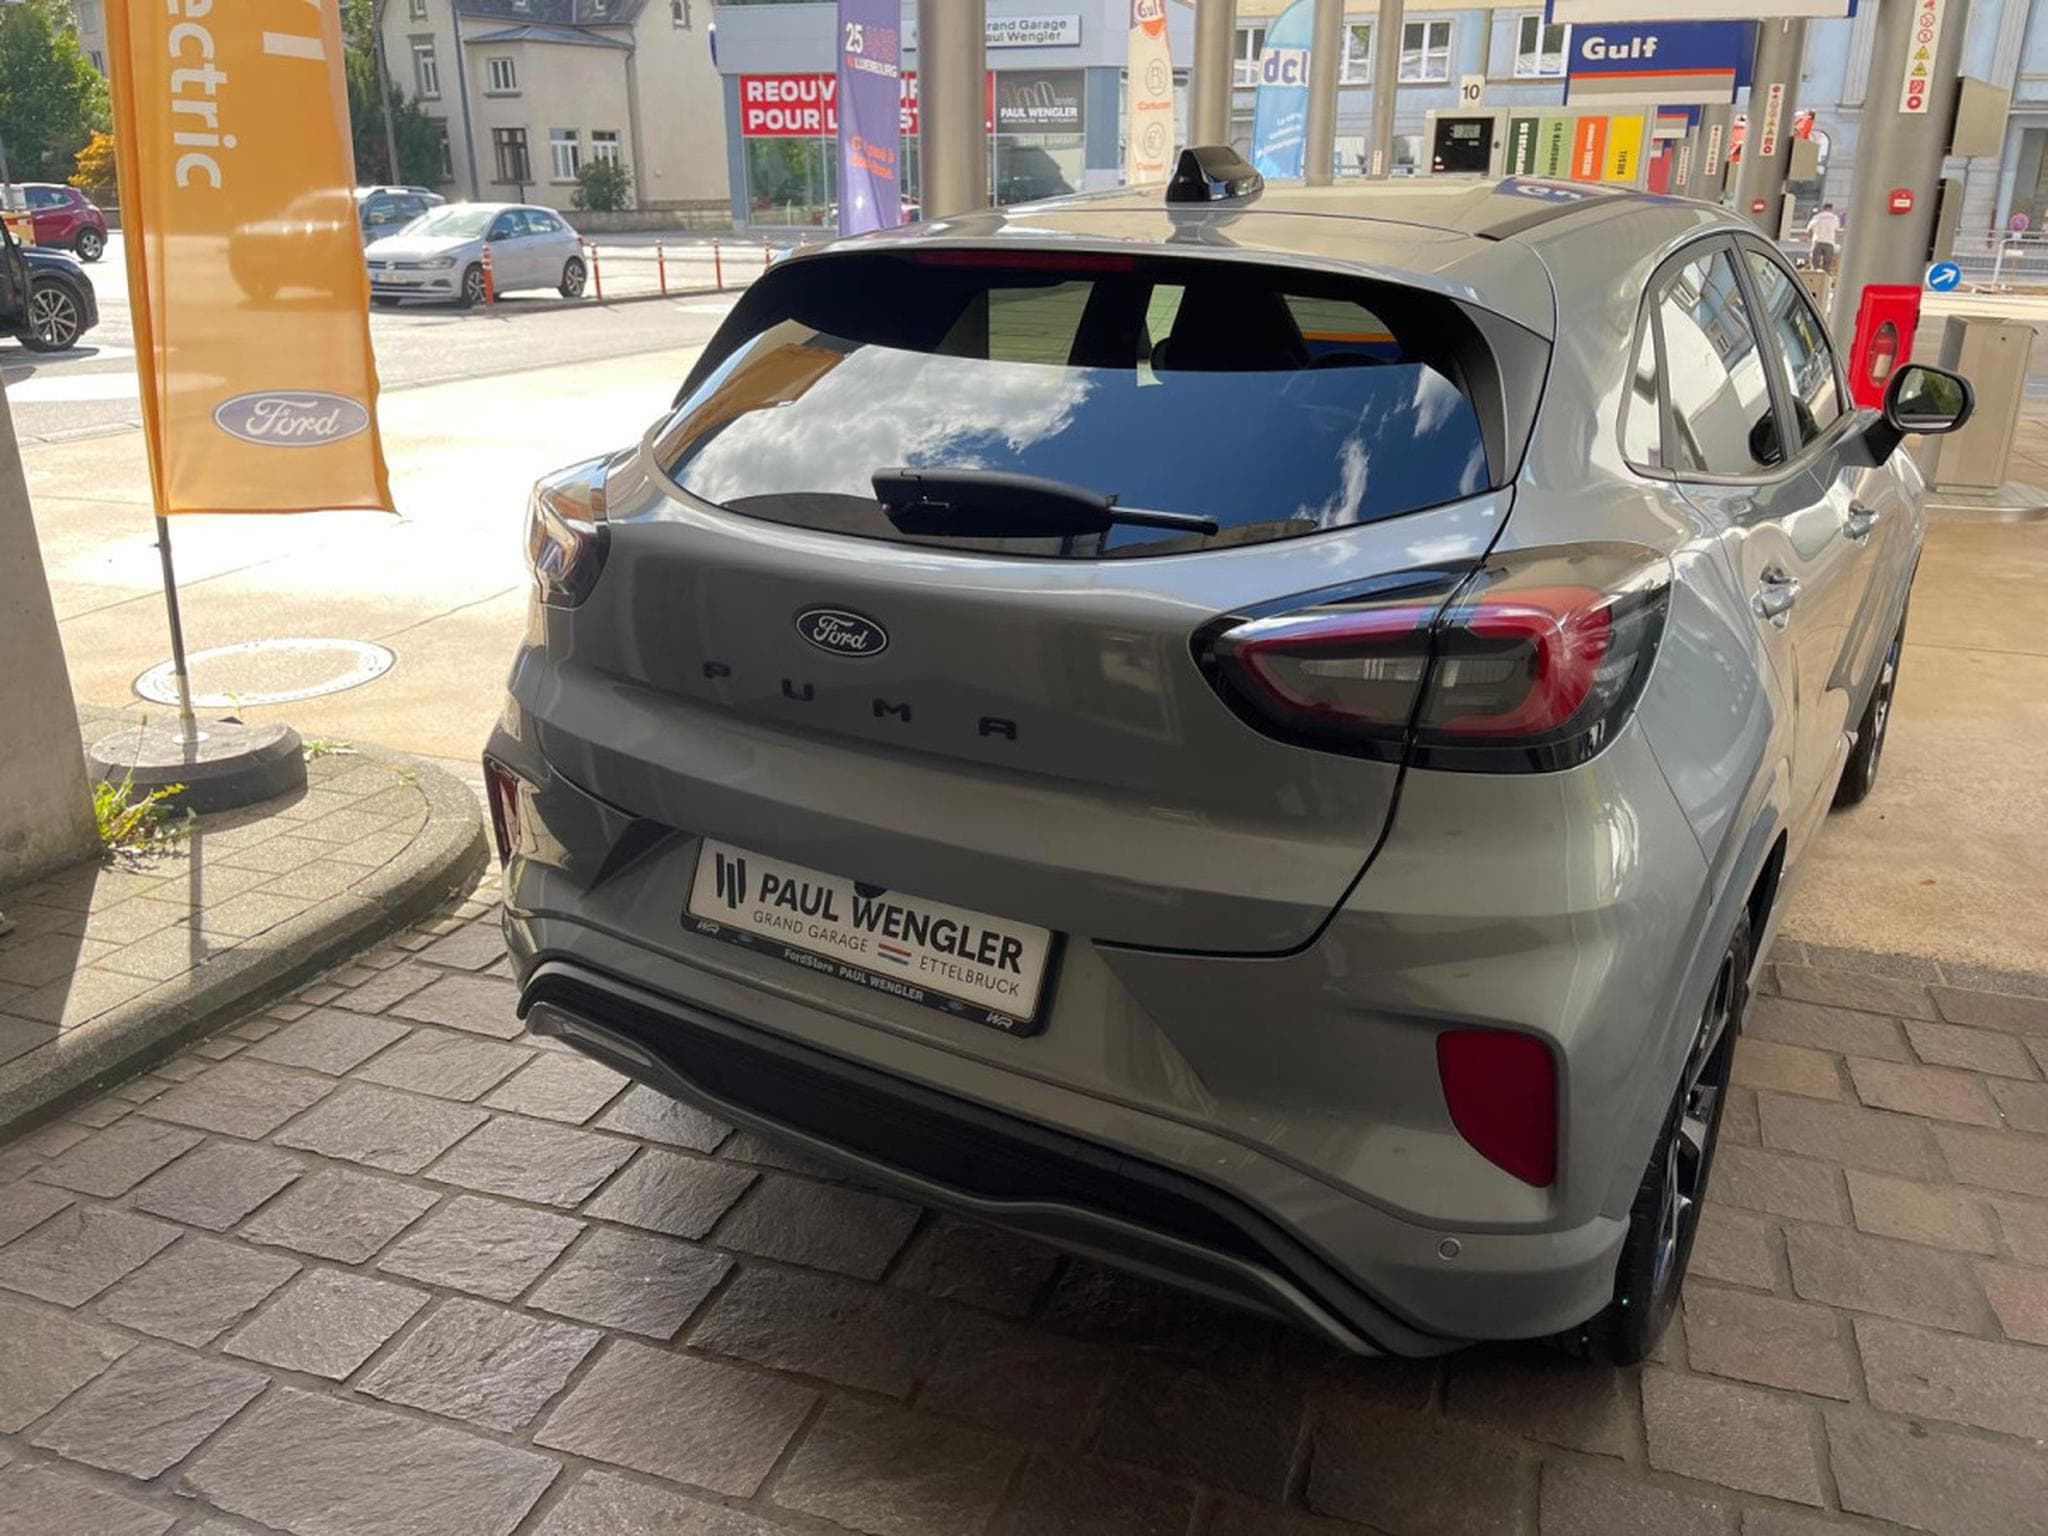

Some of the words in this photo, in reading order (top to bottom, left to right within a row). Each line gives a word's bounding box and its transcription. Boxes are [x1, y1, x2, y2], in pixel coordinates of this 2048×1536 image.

[845, 22, 863, 54] 25
[985, 32, 1004, 41] aul
[1007, 31, 1061, 43] Wengler
[986, 21, 1016, 31] rand
[1019, 19, 1067, 31] Garage
[1581, 36, 1658, 60] Gulf
[1264, 50, 1308, 84] dcl
[747, 79, 838, 102] REOUV
[1462, 84, 1480, 100] 10
[748, 109, 820, 129] POUR
[1001, 107, 1026, 118] PAUL
[1028, 107, 1078, 118] WENGLER
[246, 399, 341, 436] Ford
[813, 614, 868, 650] Ford
[703, 660, 1018, 741] PUMA
[759, 873, 839, 922] PAUL
[852, 895, 1023, 975] WENGLER
[753, 910, 803, 934] GRAND
[808, 924, 869, 953] GARAGE
[919, 956, 1021, 997] ETTELBRUCK
[784, 948, 834, 973] FordStore
[839, 966, 867, 984] PAUL
[870, 975, 925, 1001] WENGLER
